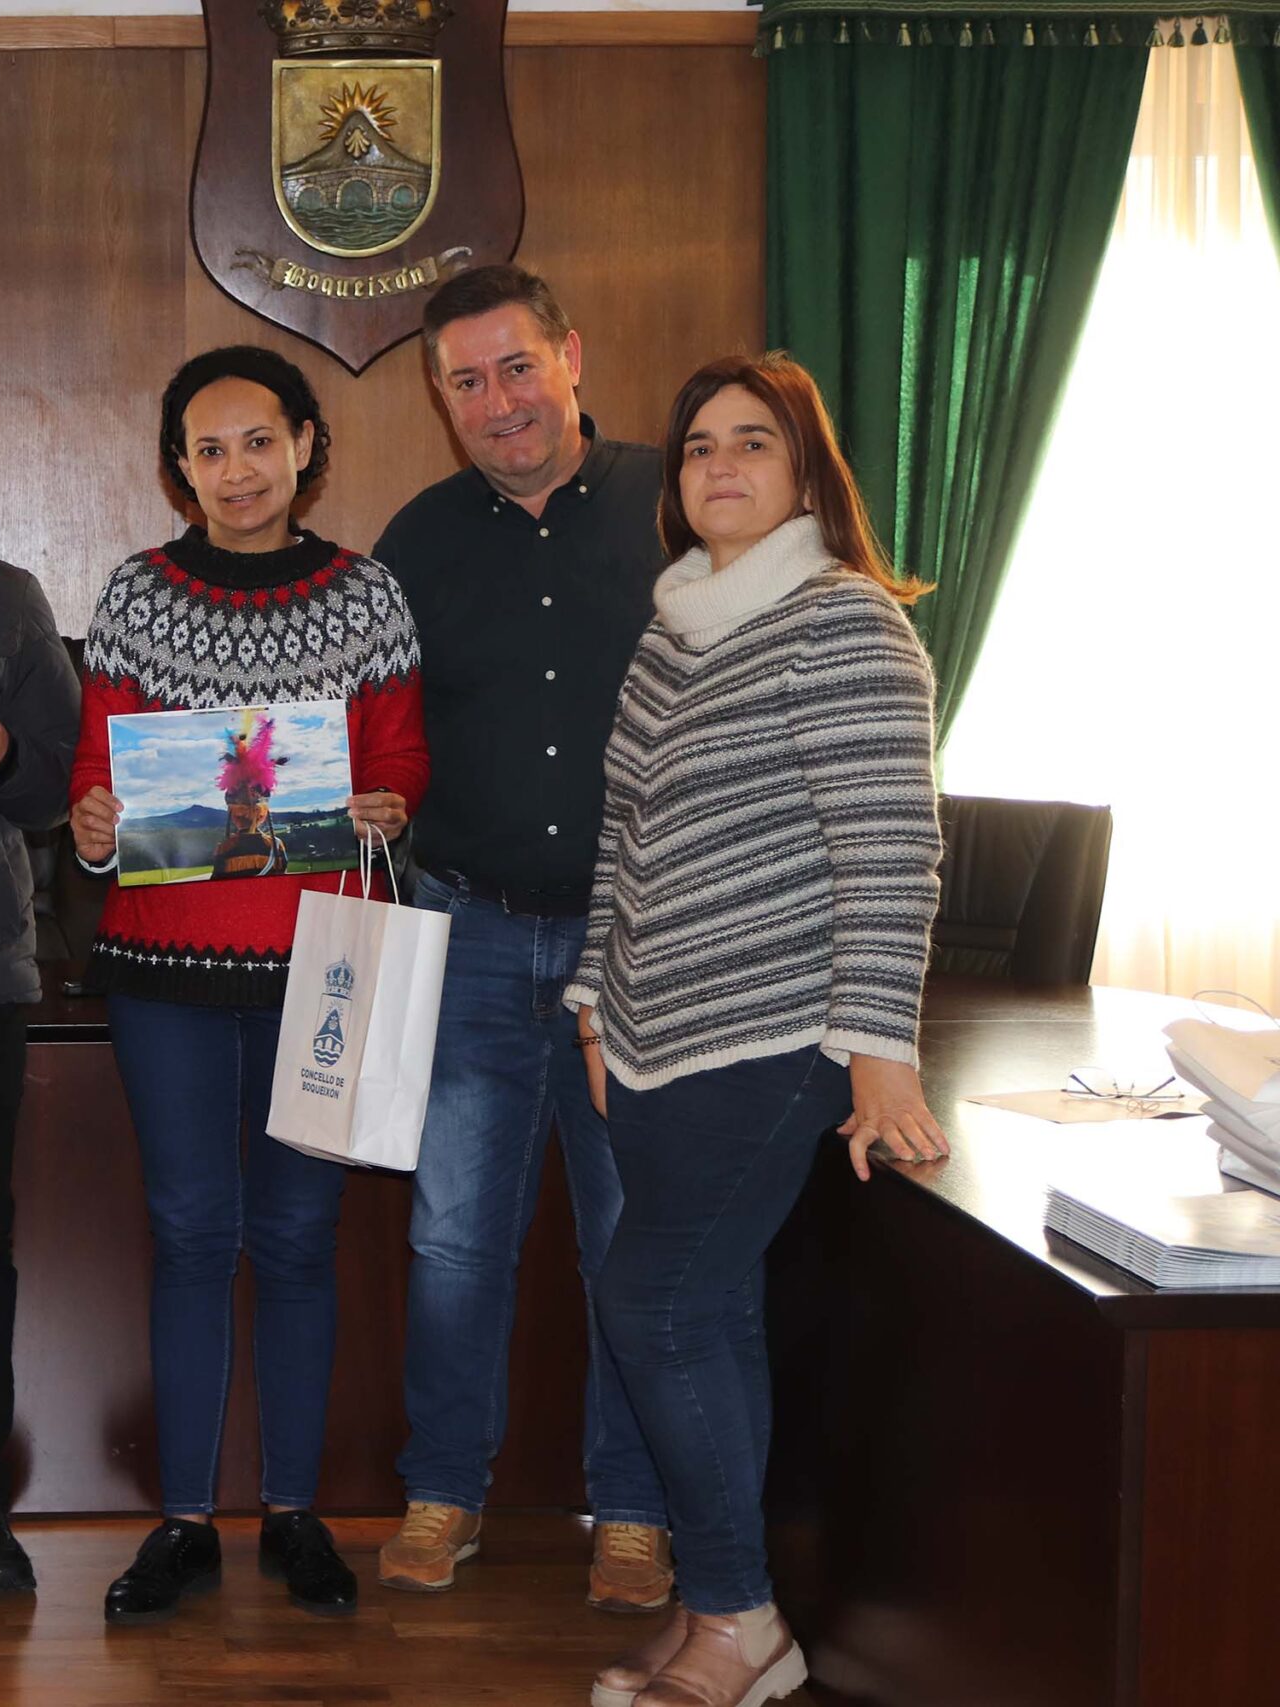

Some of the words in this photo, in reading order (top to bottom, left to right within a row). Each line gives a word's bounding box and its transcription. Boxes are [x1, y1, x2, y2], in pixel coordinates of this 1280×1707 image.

[283, 261, 425, 297] Boqueixón
[301, 1068, 335, 1085] CONCELLO
[335, 1077, 345, 1088] DE
